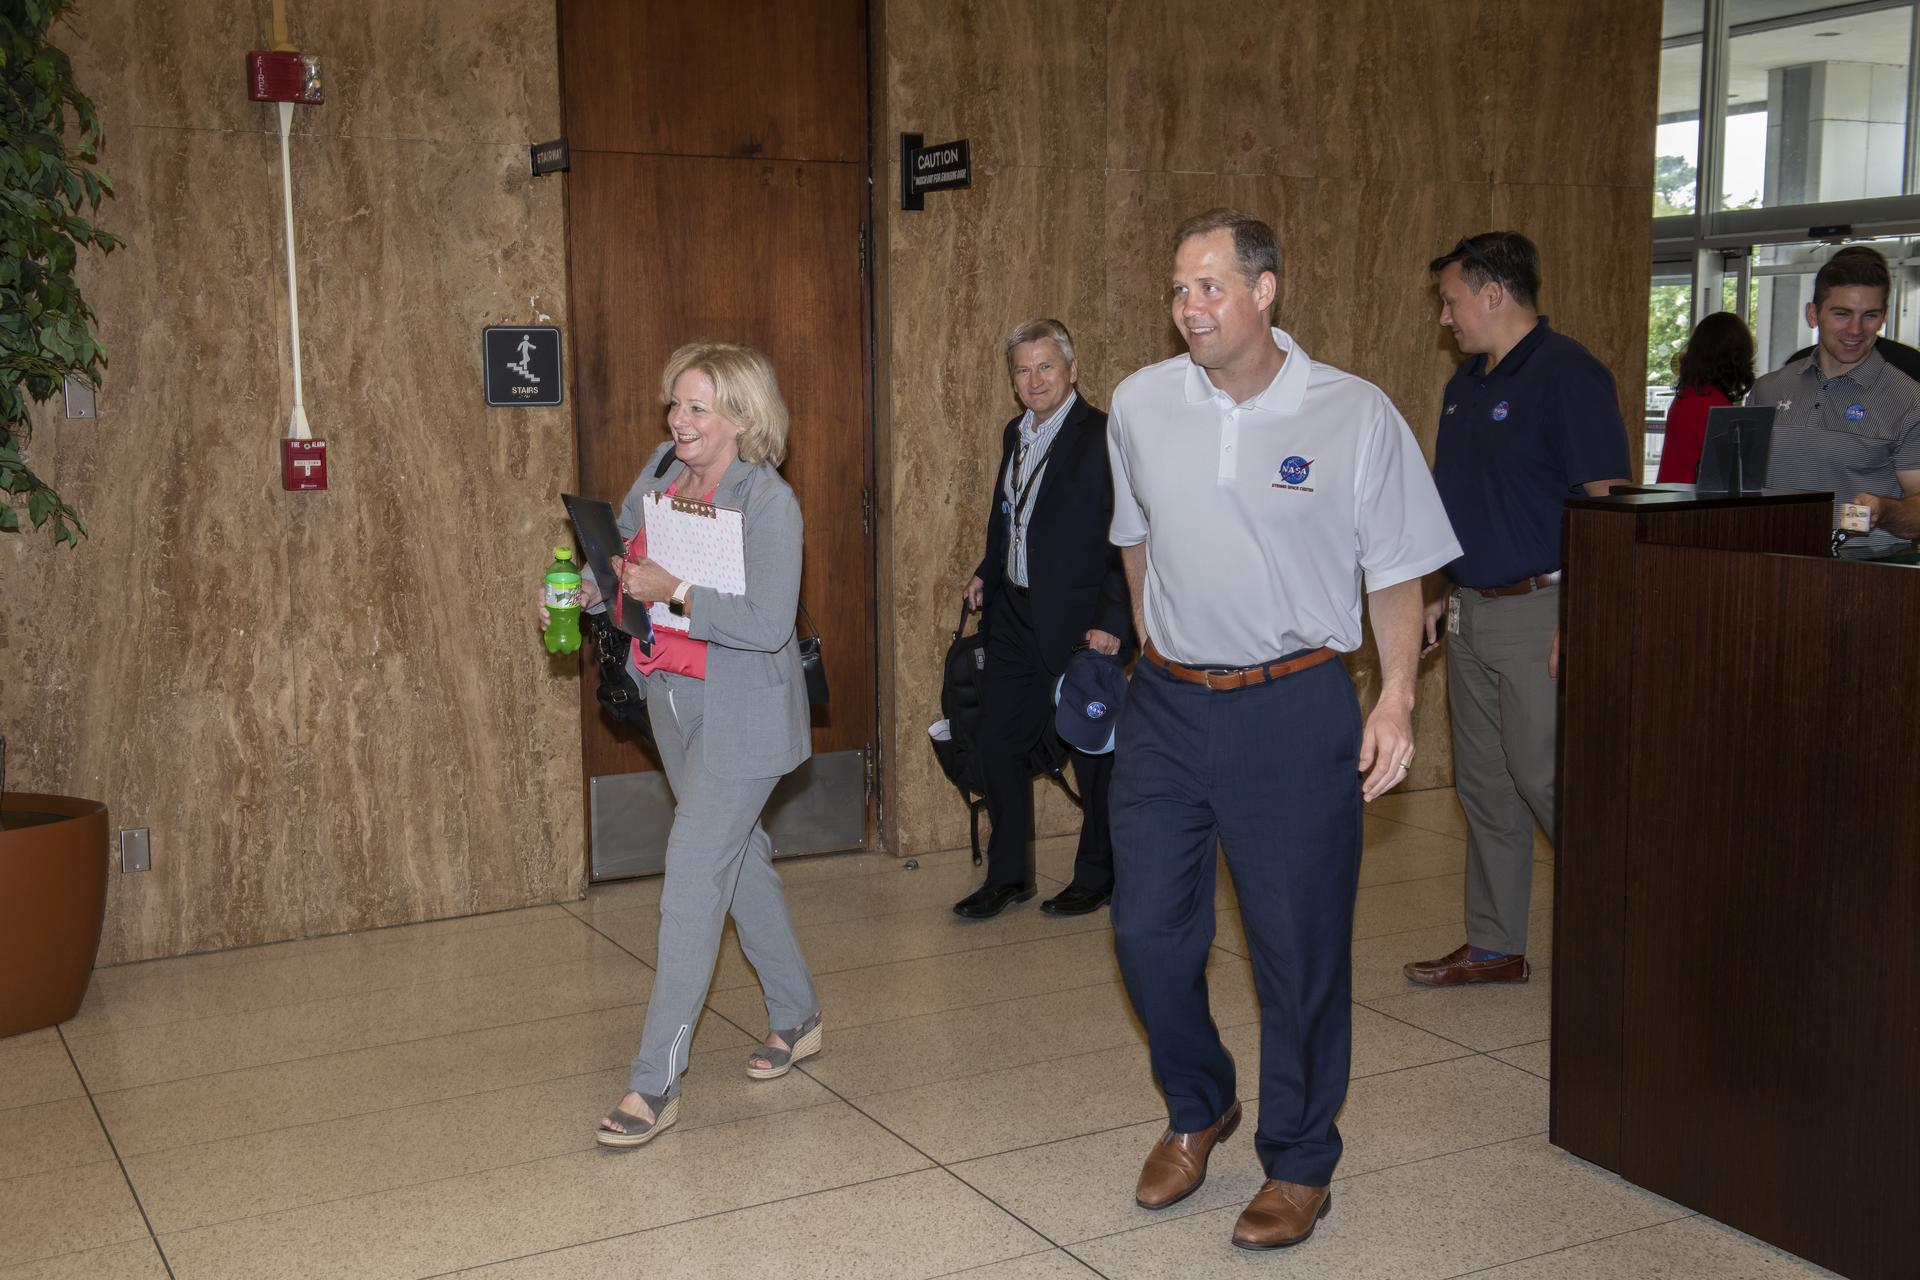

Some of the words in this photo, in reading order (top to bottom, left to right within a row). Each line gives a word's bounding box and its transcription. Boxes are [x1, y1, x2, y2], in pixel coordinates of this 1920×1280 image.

[257, 59, 265, 91] FIRE
[537, 147, 562, 164] STAIRWAY
[917, 148, 959, 170] CAUTION
[511, 386, 539, 394] STAIRS
[1282, 465, 1308, 475] NASA
